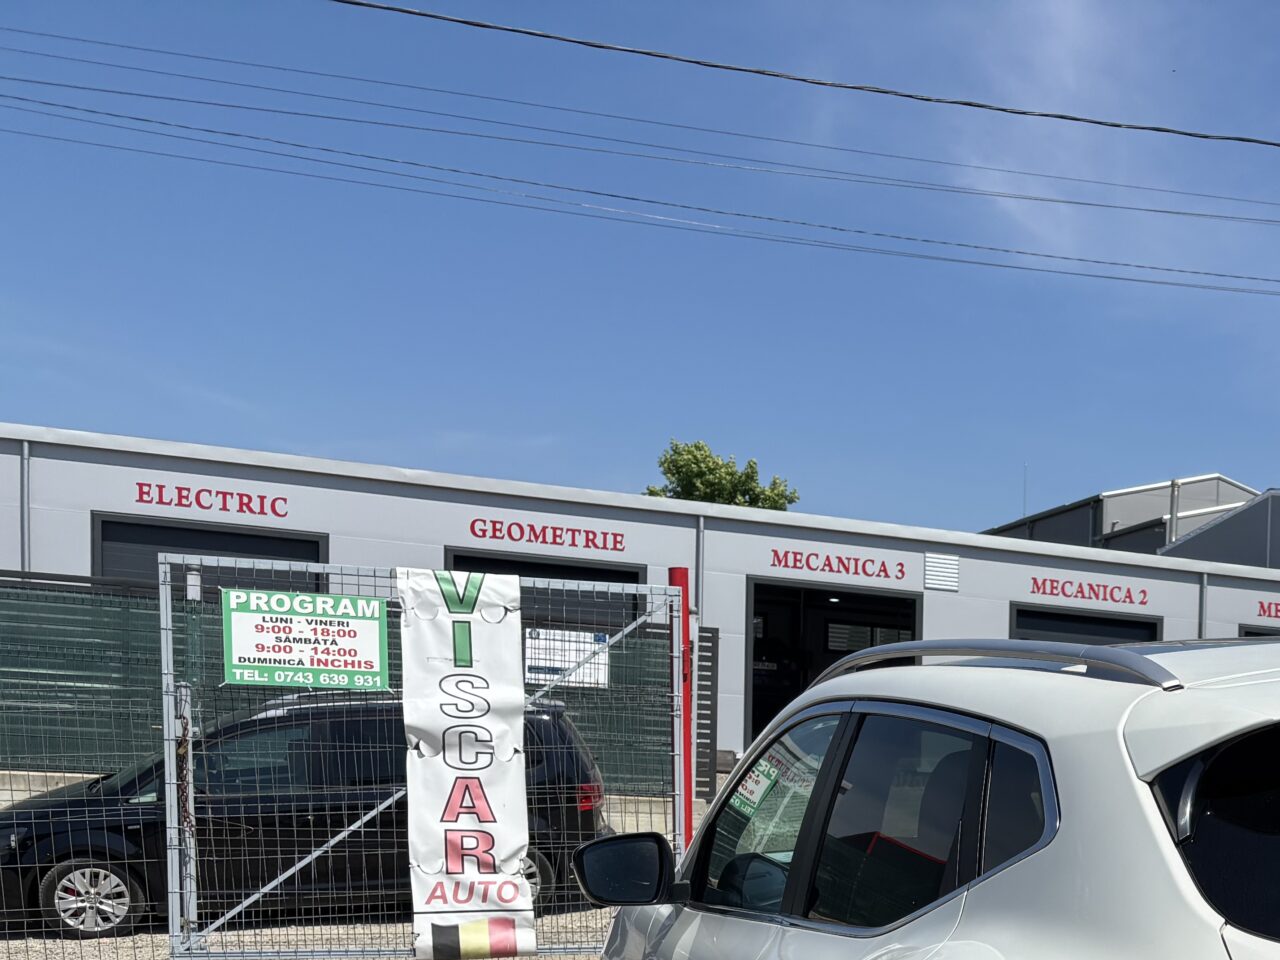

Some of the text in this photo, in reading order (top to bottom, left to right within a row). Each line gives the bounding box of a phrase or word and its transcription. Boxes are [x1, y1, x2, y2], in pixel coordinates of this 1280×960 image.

[135, 482, 289, 518] ELECTRIC
[469, 518, 626, 552] GEOMETRIE
[770, 549, 906, 580] MECANICA 3
[229, 591, 380, 618] PROGRAM
[1030, 577, 1149, 606] MECANICA 2
[254, 624, 293, 635] 9:00
[310, 627, 357, 639] 18:00
[261, 615, 293, 625] LUNI
[304, 618, 350, 628] VINERI
[255, 643, 293, 654] 9:00
[310, 646, 358, 658] 14:00
[309, 655, 375, 670] ÎNCHIS
[232, 668, 381, 687] TEL: 0743 639 931
[433, 570, 499, 875] VISCAR
[424, 880, 520, 905] AUTO
